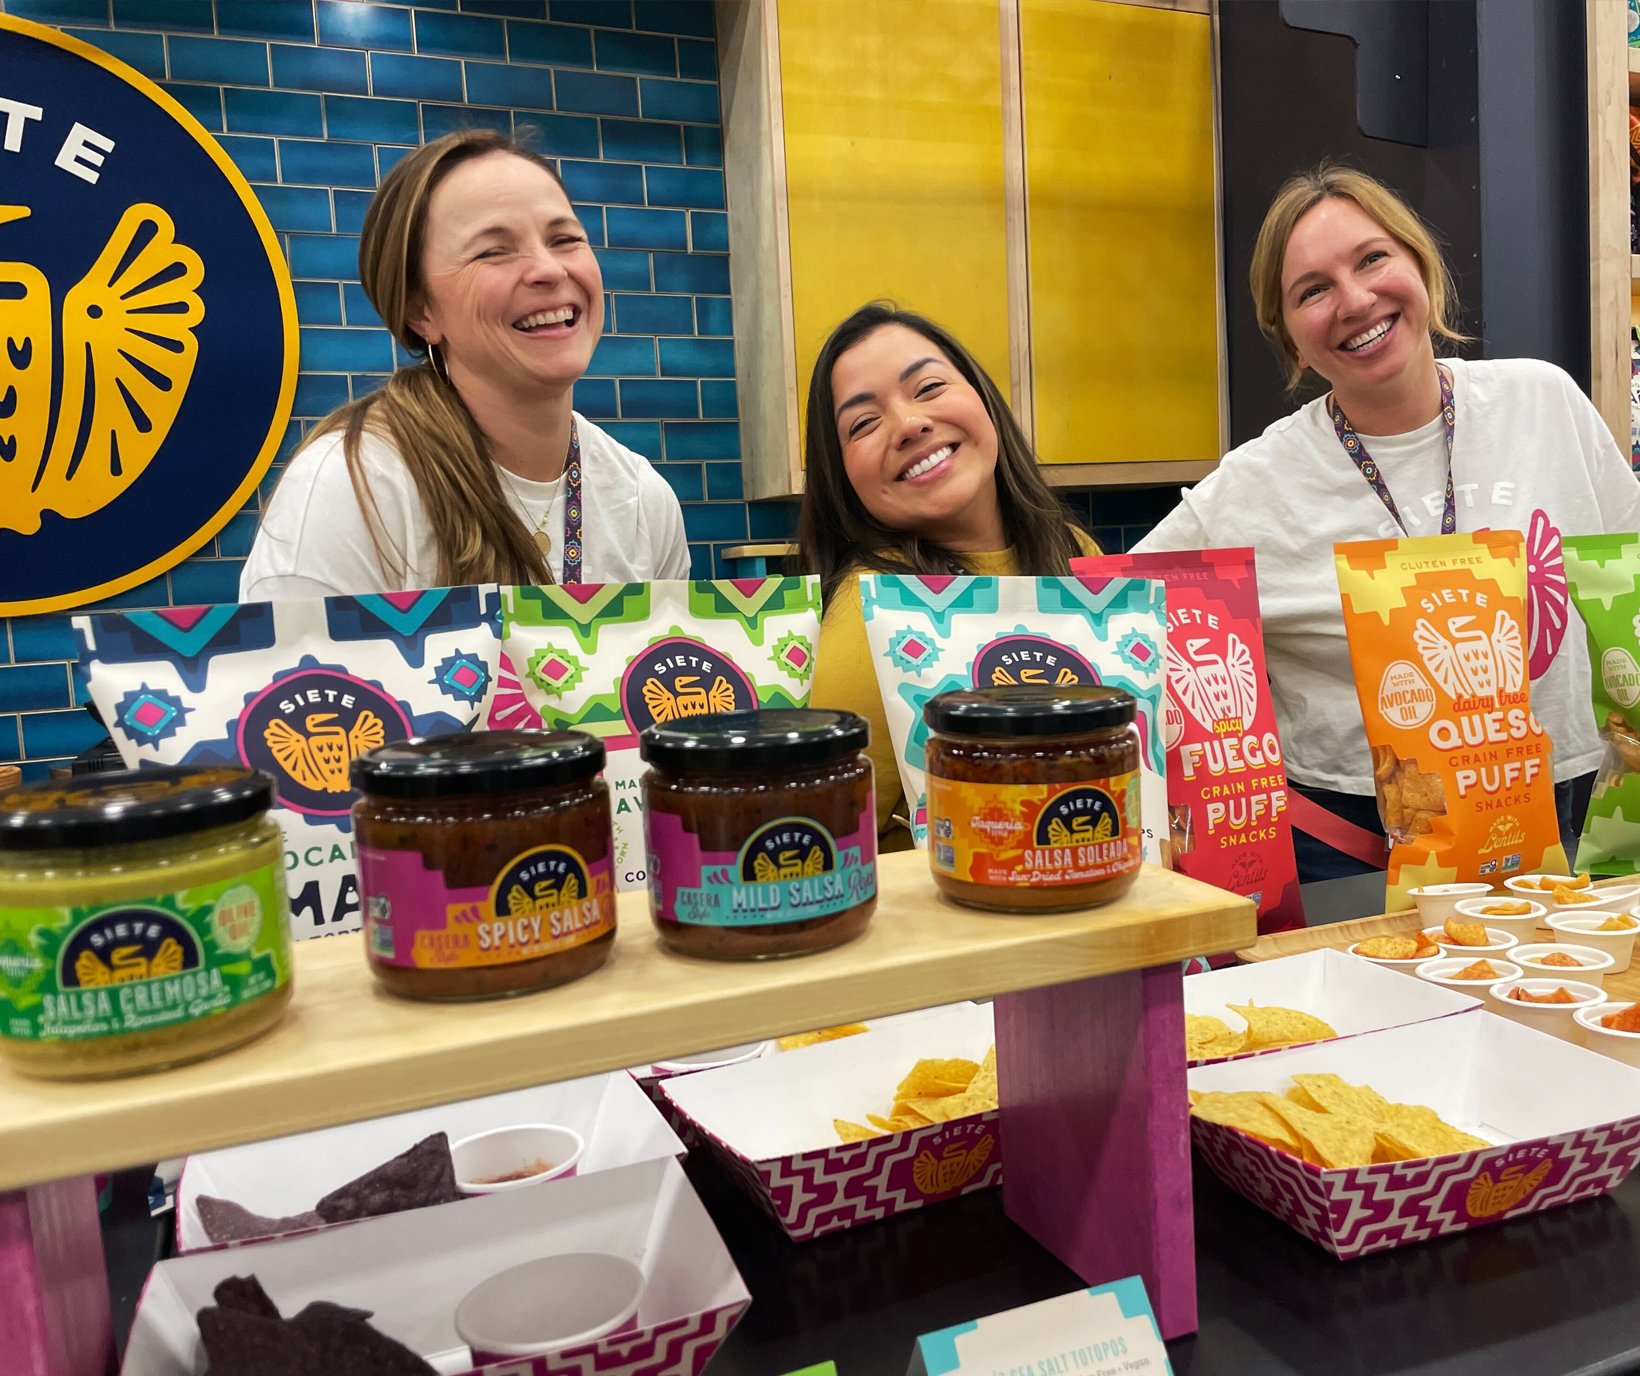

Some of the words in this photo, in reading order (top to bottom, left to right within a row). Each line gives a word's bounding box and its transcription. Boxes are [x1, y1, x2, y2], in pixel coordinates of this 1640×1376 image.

[1400, 560, 1447, 571] GLUTEN
[1451, 556, 1484, 567] FREE
[1421, 588, 1488, 613] SIETE
[654, 655, 713, 675] SIETE
[1001, 651, 1058, 666] SIETE
[1391, 672, 1415, 680] MADE
[1392, 679, 1416, 687] WITH
[278, 689, 356, 714] SIETE
[1381, 688, 1435, 711] AVOCADO
[1452, 695, 1495, 714] dairy
[1498, 690, 1529, 706] free
[1616, 689, 1630, 701] OIL
[1400, 705, 1420, 721] OIL
[1213, 714, 1244, 738] spicy
[1180, 732, 1282, 781] FUEGO
[1448, 752, 1498, 768] GRAIN
[1506, 744, 1542, 759] FREE
[1201, 781, 1245, 800] GRAIN
[1252, 774, 1285, 791] FREE
[1455, 758, 1541, 799] PUFF
[1059, 798, 1103, 816] SIETE
[1206, 790, 1288, 835] PUFF
[1475, 793, 1531, 812] SNACKS
[765, 832, 812, 850] SIETE
[1220, 826, 1277, 849] SNACKS
[1478, 830, 1526, 854] Lentils
[1024, 848, 1072, 869] SALSA
[1078, 838, 1128, 866] SOLEADA
[519, 860, 568, 881] SIETE
[681, 890, 720, 908] CASERA
[732, 884, 781, 912] MILD
[789, 873, 844, 908] SALSA
[90, 922, 163, 947] SIETE
[477, 913, 543, 953] SPICY
[550, 898, 600, 939] SALSA
[43, 990, 112, 1019] SALSA
[119, 968, 223, 1012] CREMOSA
[932, 1124, 986, 1146] SIETE
[1495, 1147, 1549, 1168] SIETE
[1037, 1353, 1069, 1376] SALT
[1070, 1336, 1128, 1368] TOTOPOS
[1122, 1357, 1150, 1372] Vegan
